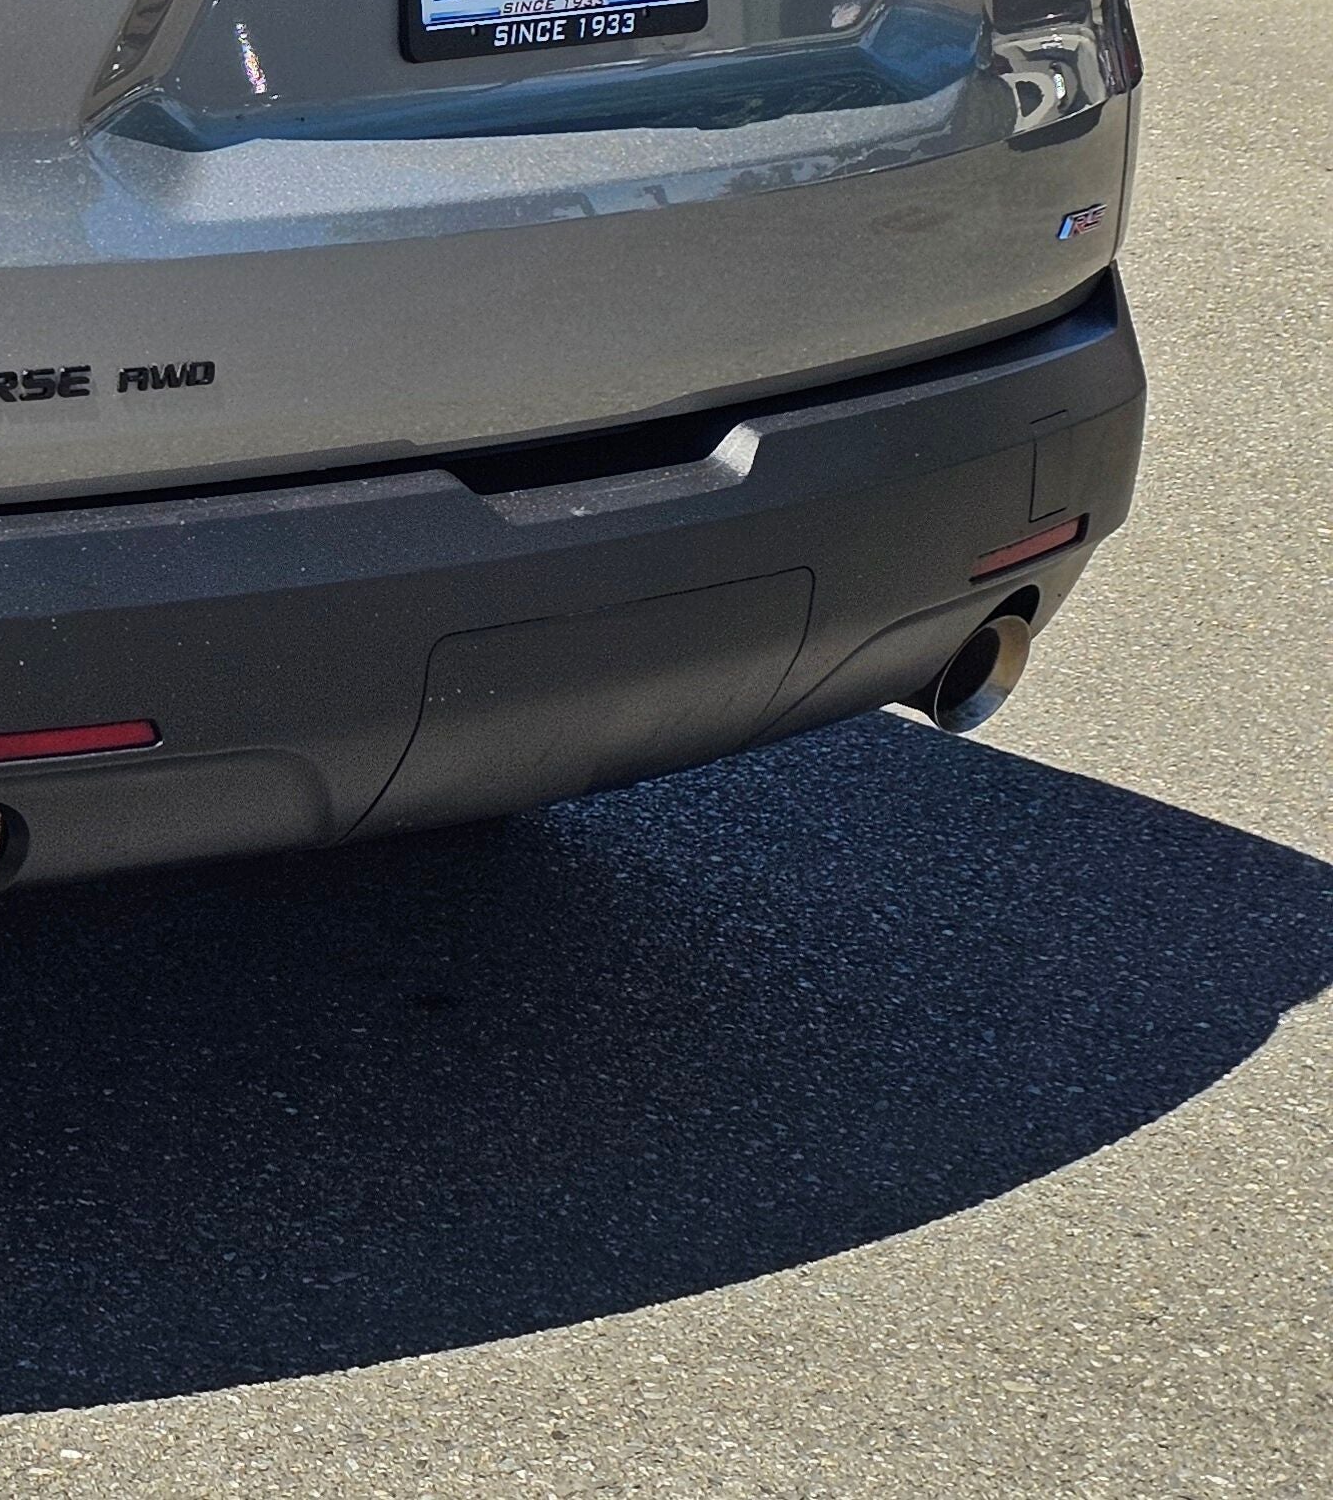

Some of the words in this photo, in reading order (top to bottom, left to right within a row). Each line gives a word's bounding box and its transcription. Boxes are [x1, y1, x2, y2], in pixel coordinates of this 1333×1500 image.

[493, 19, 566, 47] SINCE
[580, 13, 636, 39] 1933
[117, 361, 216, 393] AWD
